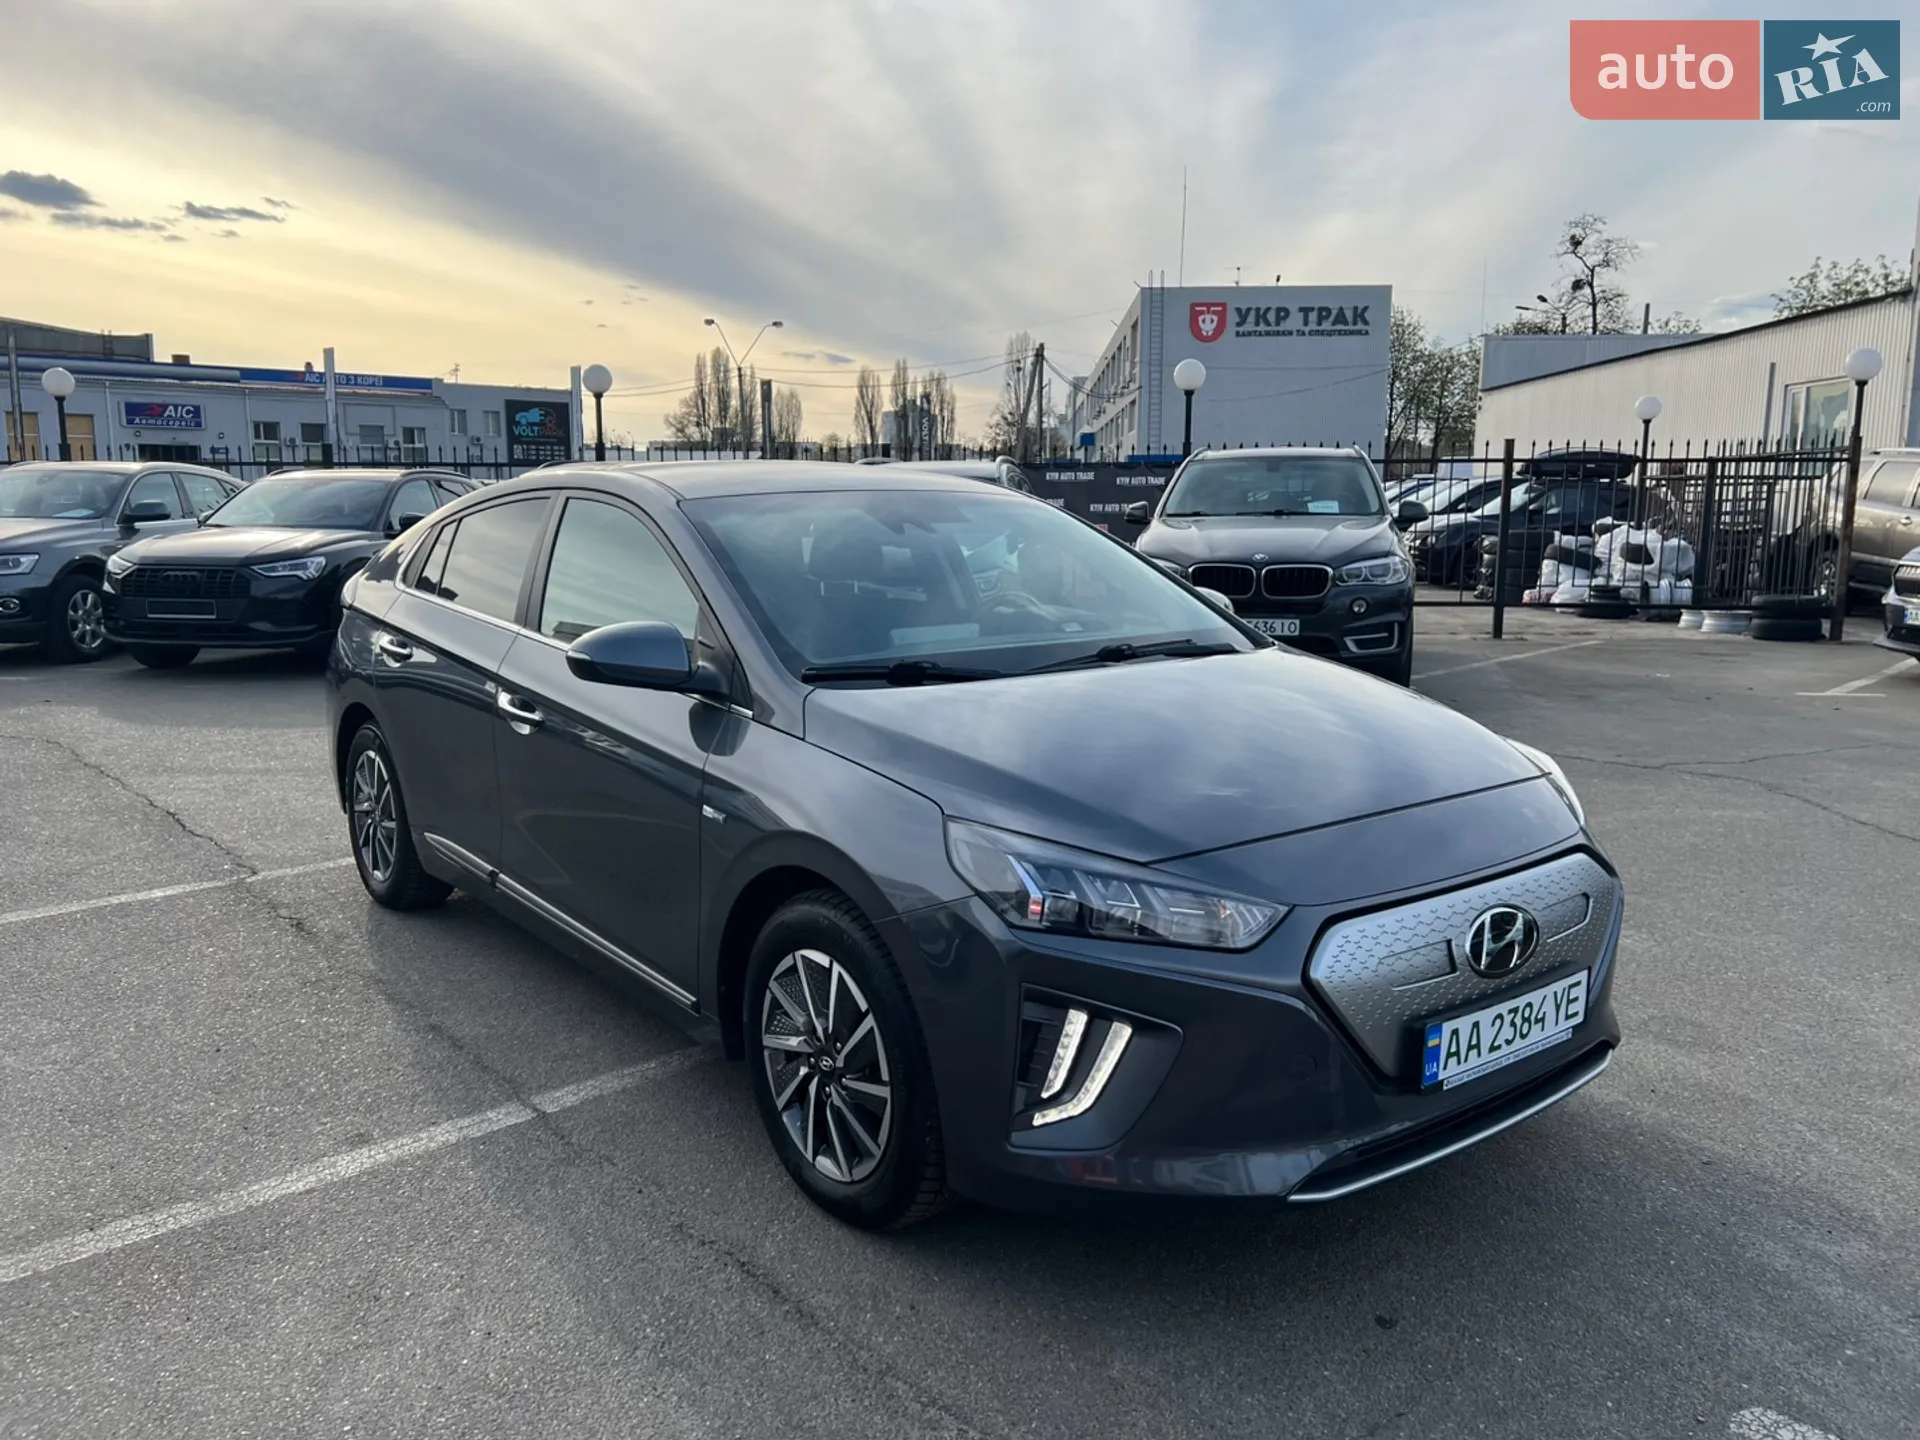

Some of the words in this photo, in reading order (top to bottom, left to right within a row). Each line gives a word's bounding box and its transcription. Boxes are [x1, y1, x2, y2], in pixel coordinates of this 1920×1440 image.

[1234, 306, 1291, 328] УКР
[1298, 305, 1371, 327] ТРАК
[1060, 472, 1075, 480] AUTO
[1076, 471, 1095, 480] TRADE
[1131, 477, 1146, 485] AUTO
[1147, 476, 1166, 485] TRADE
[1246, 621, 1277, 633] 636
[1443, 1020, 1482, 1070] AA
[1487, 994, 1548, 1055] 2384
[1553, 979, 1583, 1027] YE
[1425, 1061, 1438, 1076] UA
